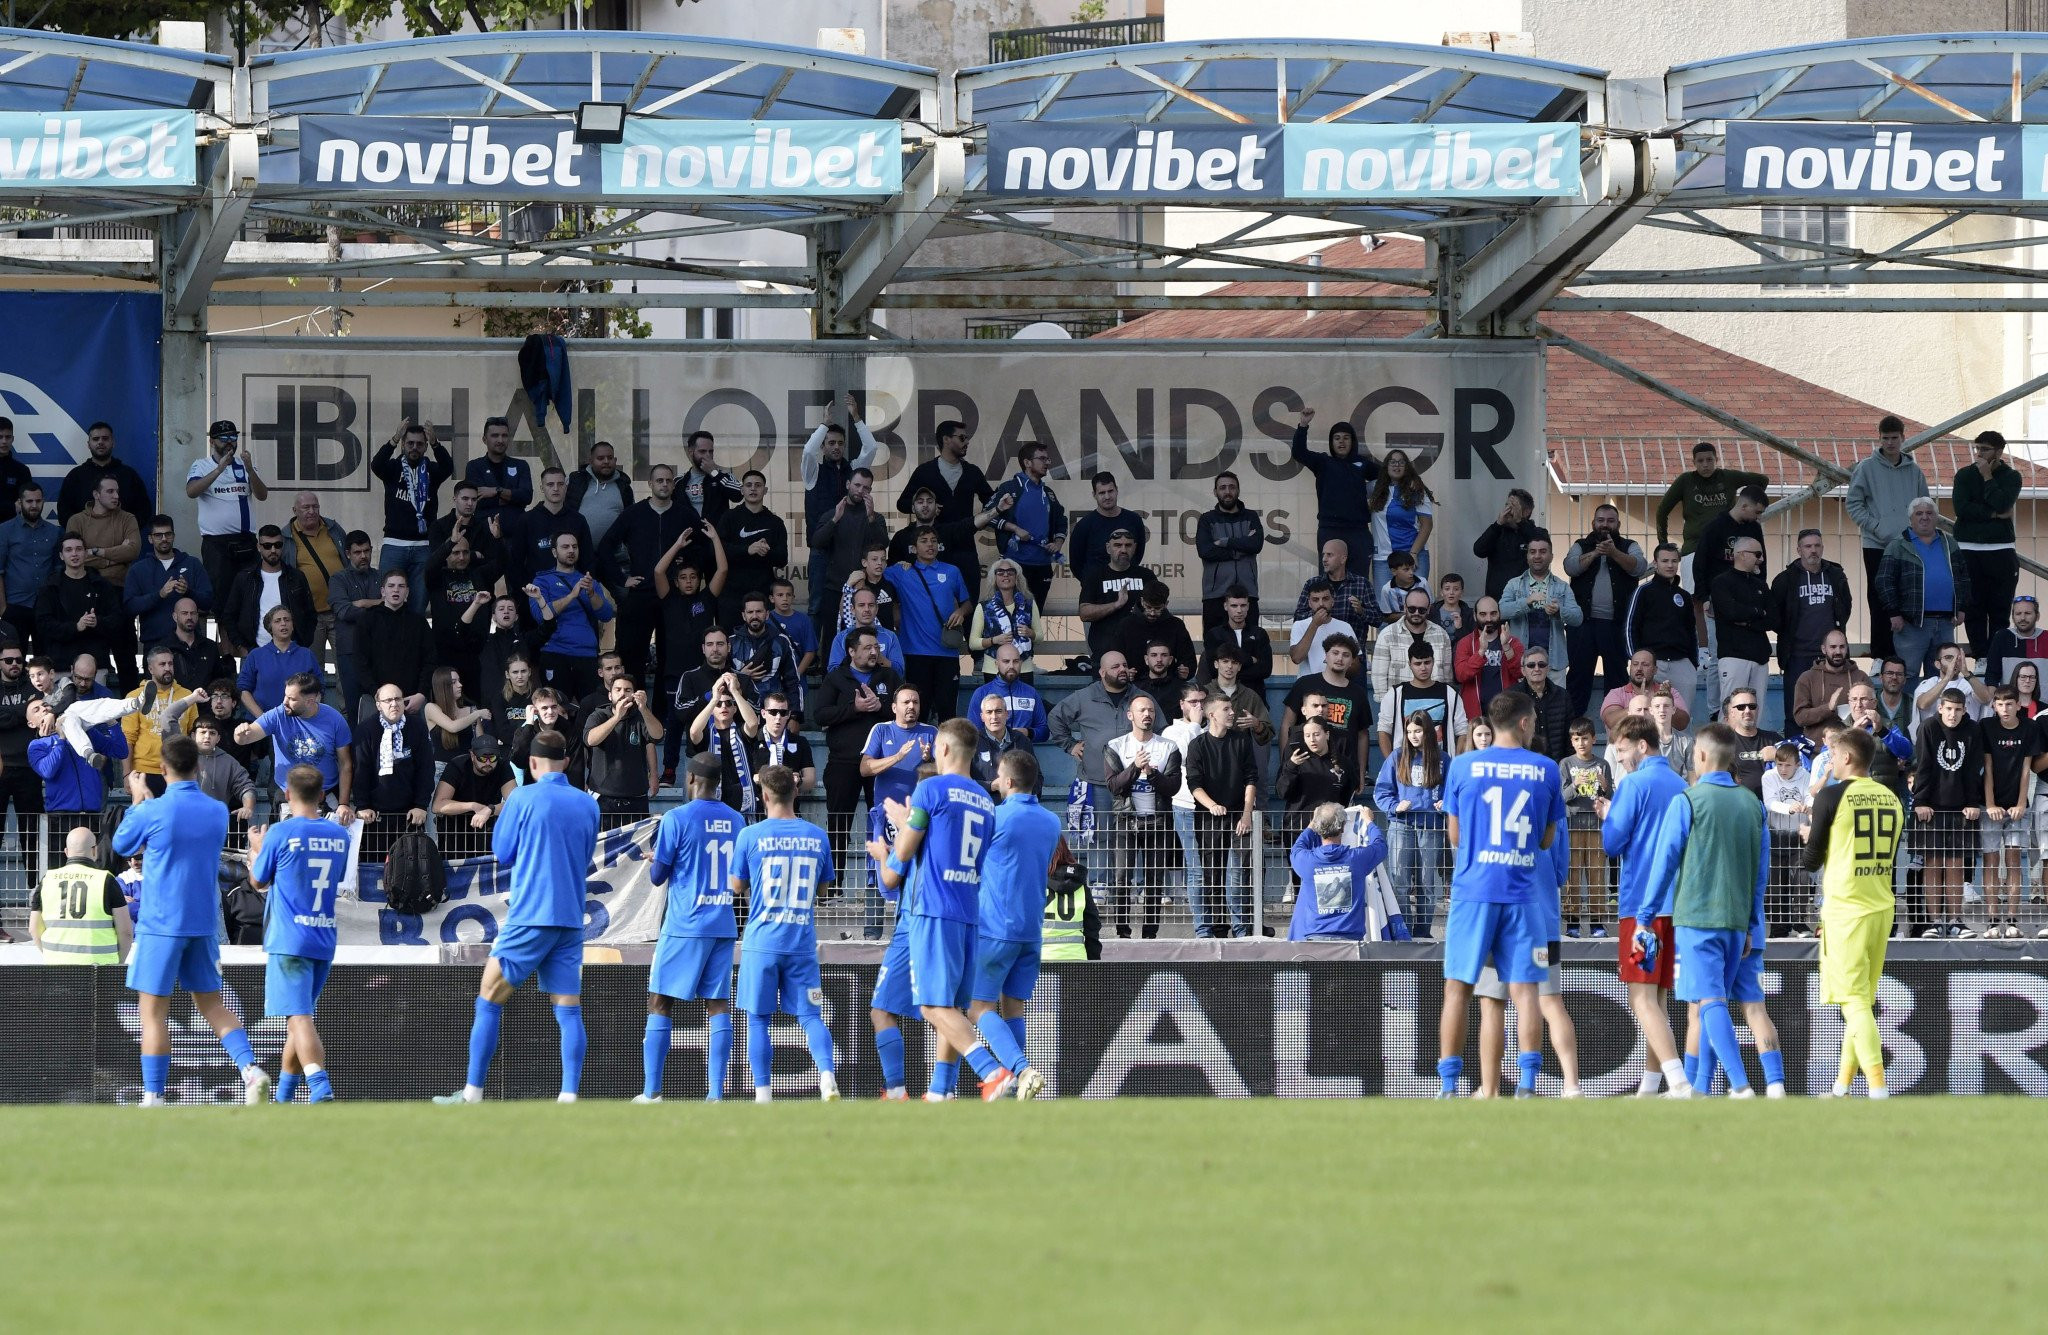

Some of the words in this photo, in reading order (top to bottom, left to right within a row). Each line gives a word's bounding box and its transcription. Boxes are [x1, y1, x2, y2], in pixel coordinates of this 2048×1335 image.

[0, 119, 177, 179] vibet
[317, 125, 583, 186] novibet
[621, 128, 884, 188] novibet
[1004, 130, 1266, 191] novibet
[1302, 131, 1564, 191] novibet
[1742, 131, 2004, 191] novibet
[214, 486, 246, 494] NetBet
[1694, 493, 1727, 503] QATAR
[1102, 577, 1144, 594] PUMA
[1470, 762, 1546, 782] STEFAN
[704, 819, 732, 834] LEO
[959, 810, 983, 867] 6
[1481, 786, 1532, 849] 14
[1854, 808, 1897, 860] 99
[288, 837, 304, 852] F.
[308, 838, 345, 852] GINO
[704, 839, 734, 889] 11
[1478, 849, 1535, 867] novibet
[58, 880, 89, 920] 10
[307, 858, 333, 911] 7
[696, 892, 734, 906] novib
[762, 856, 818, 909] 88
[760, 910, 810, 925] novibet
